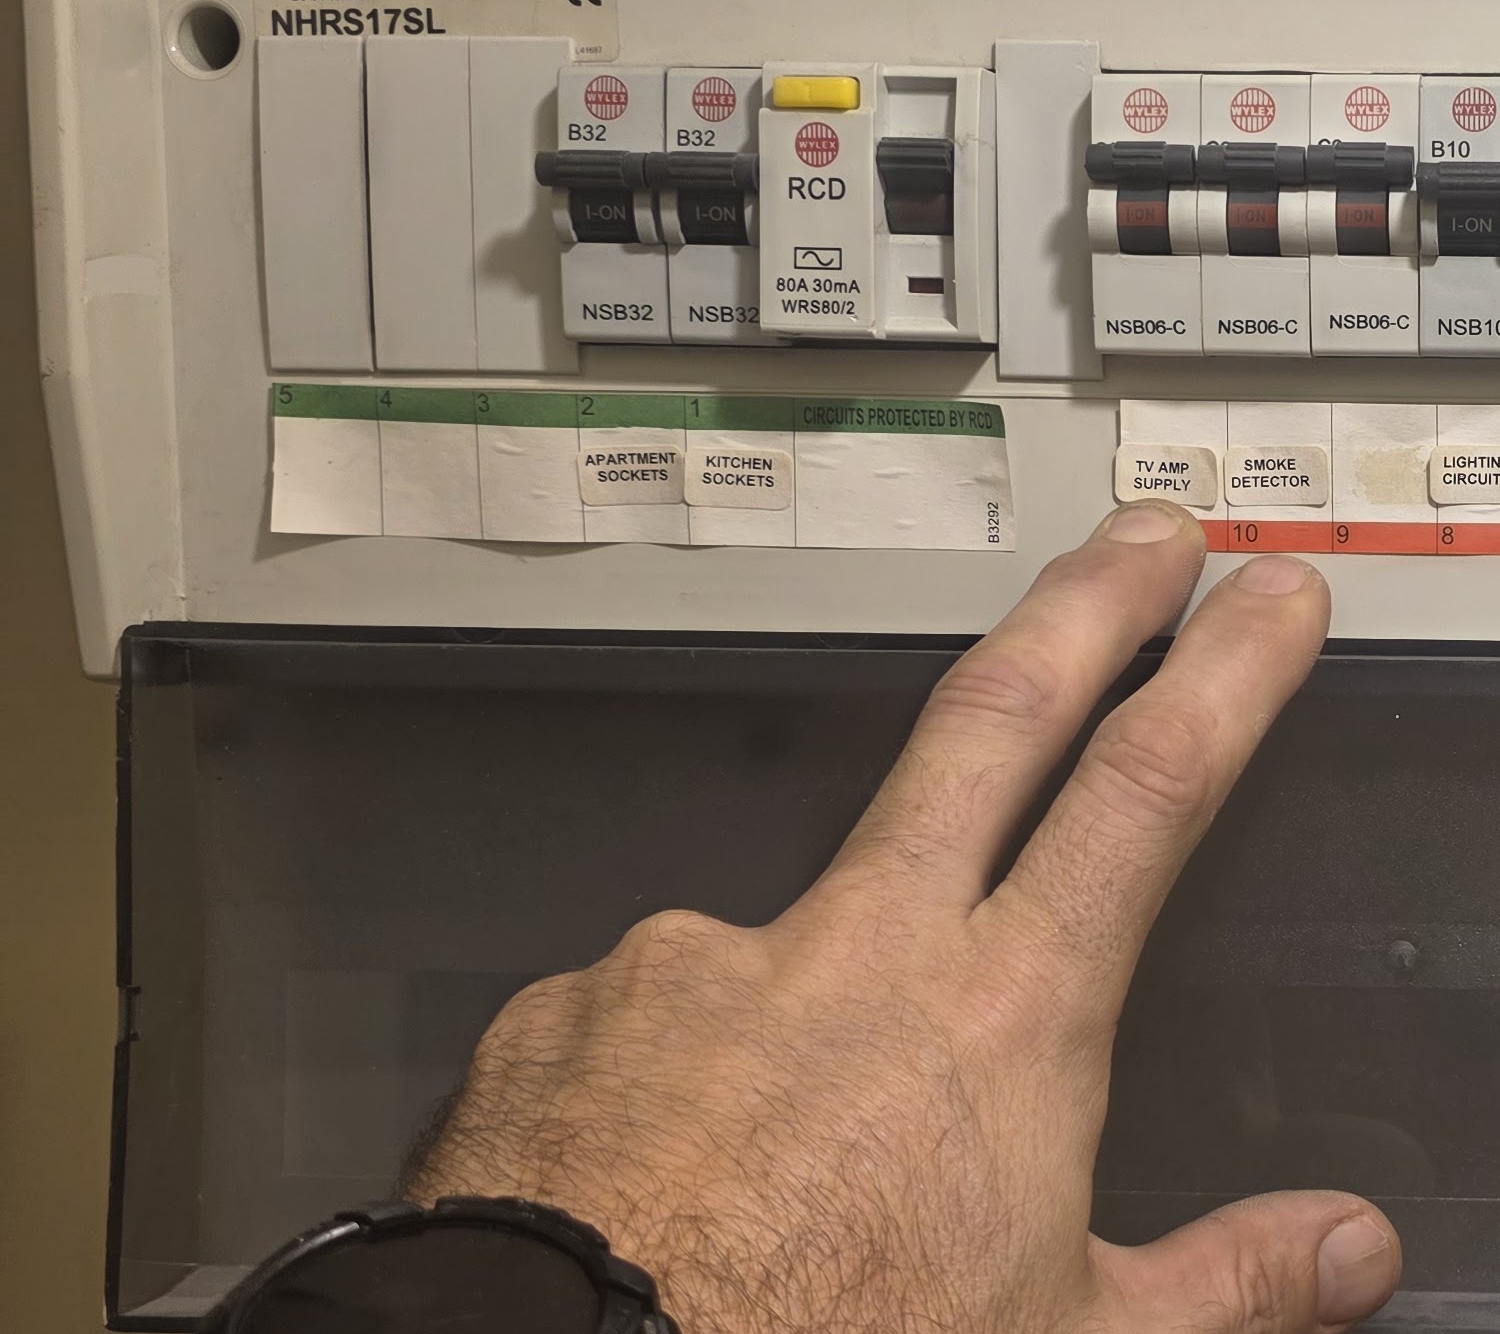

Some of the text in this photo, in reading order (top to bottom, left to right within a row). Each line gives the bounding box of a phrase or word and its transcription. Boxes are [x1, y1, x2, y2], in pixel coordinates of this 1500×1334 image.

[271, 7, 446, 36] NHRS17SL
[587, 93, 627, 103] WYLEX
[694, 95, 735, 105] WYLEX
[1453, 105, 1496, 115] WYLEX
[568, 123, 607, 142] B32
[676, 129, 716, 147] B32
[799, 140, 837, 150] WYLEX
[1431, 140, 1470, 158] B10
[788, 177, 846, 200] RCD
[776, 278, 861, 294] 80A 30mA
[582, 303, 654, 321] NSB32
[689, 306, 759, 323] NSB32
[781, 299, 856, 315] WRS80/2
[1106, 319, 1186, 335] NSB06-C
[1218, 319, 1298, 335] NSB06-C
[1329, 314, 1410, 330] NSB06-C
[279, 385, 293, 404] 5
[379, 390, 393, 408] 4
[477, 393, 490, 412] 3
[580, 396, 595, 416] 2
[690, 398, 701, 418] 1
[803, 406, 993, 430] CIRCUITS PROTECTED BY RCD
[585, 452, 677, 466] APARTMENT
[706, 456, 773, 471] KITCHEN
[1244, 458, 1297, 471] SMOKE
[597, 469, 668, 482] SOCKETS
[1136, 461, 1190, 475] TV AMP
[702, 472, 775, 488] SOCKETS
[1133, 478, 1191, 492] SUPPLY
[1231, 475, 1310, 488] DETECTOR
[987, 502, 1000, 544] B3292
[1233, 524, 1258, 543] 10
[1336, 525, 1350, 545] 9
[1441, 525, 1455, 545] 8
